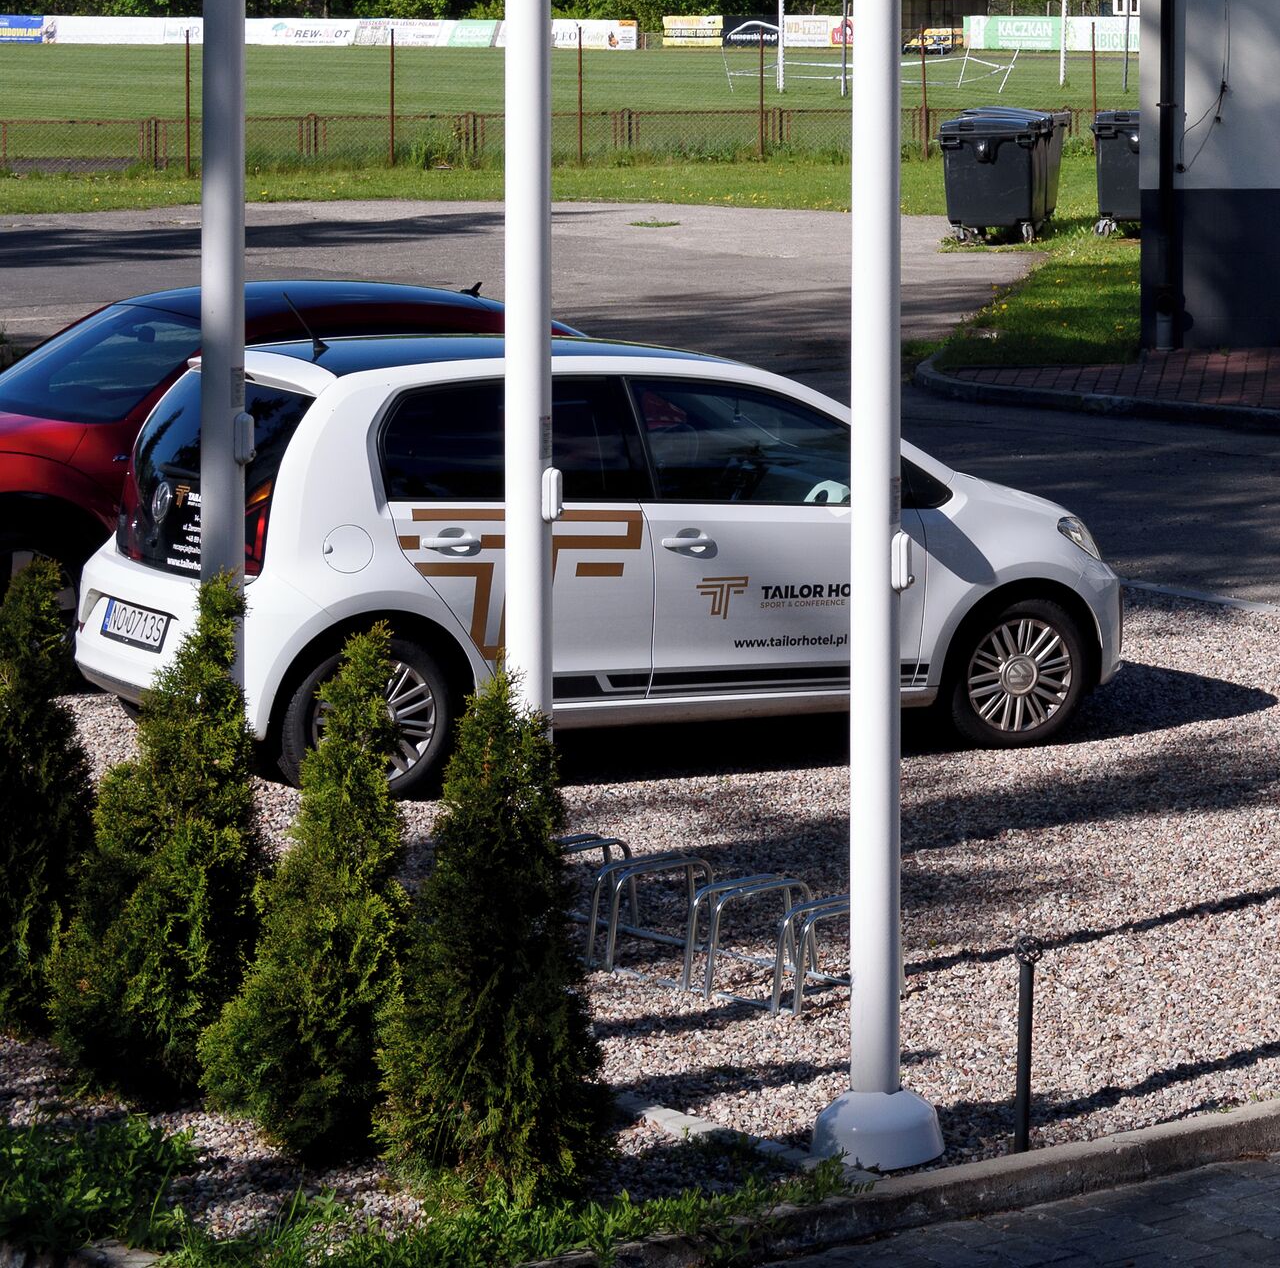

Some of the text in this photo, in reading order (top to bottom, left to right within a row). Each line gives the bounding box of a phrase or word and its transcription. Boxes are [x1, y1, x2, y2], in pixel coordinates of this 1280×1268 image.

[998, 21, 1052, 36] KACZKAN
[167, 557, 201, 570] www.tailorho
[761, 584, 824, 600] TAILOR
[760, 601, 785, 609] SPORT
[794, 599, 846, 608] CONFERENCE
[734, 634, 848, 648] www.tailorhotel.pl
